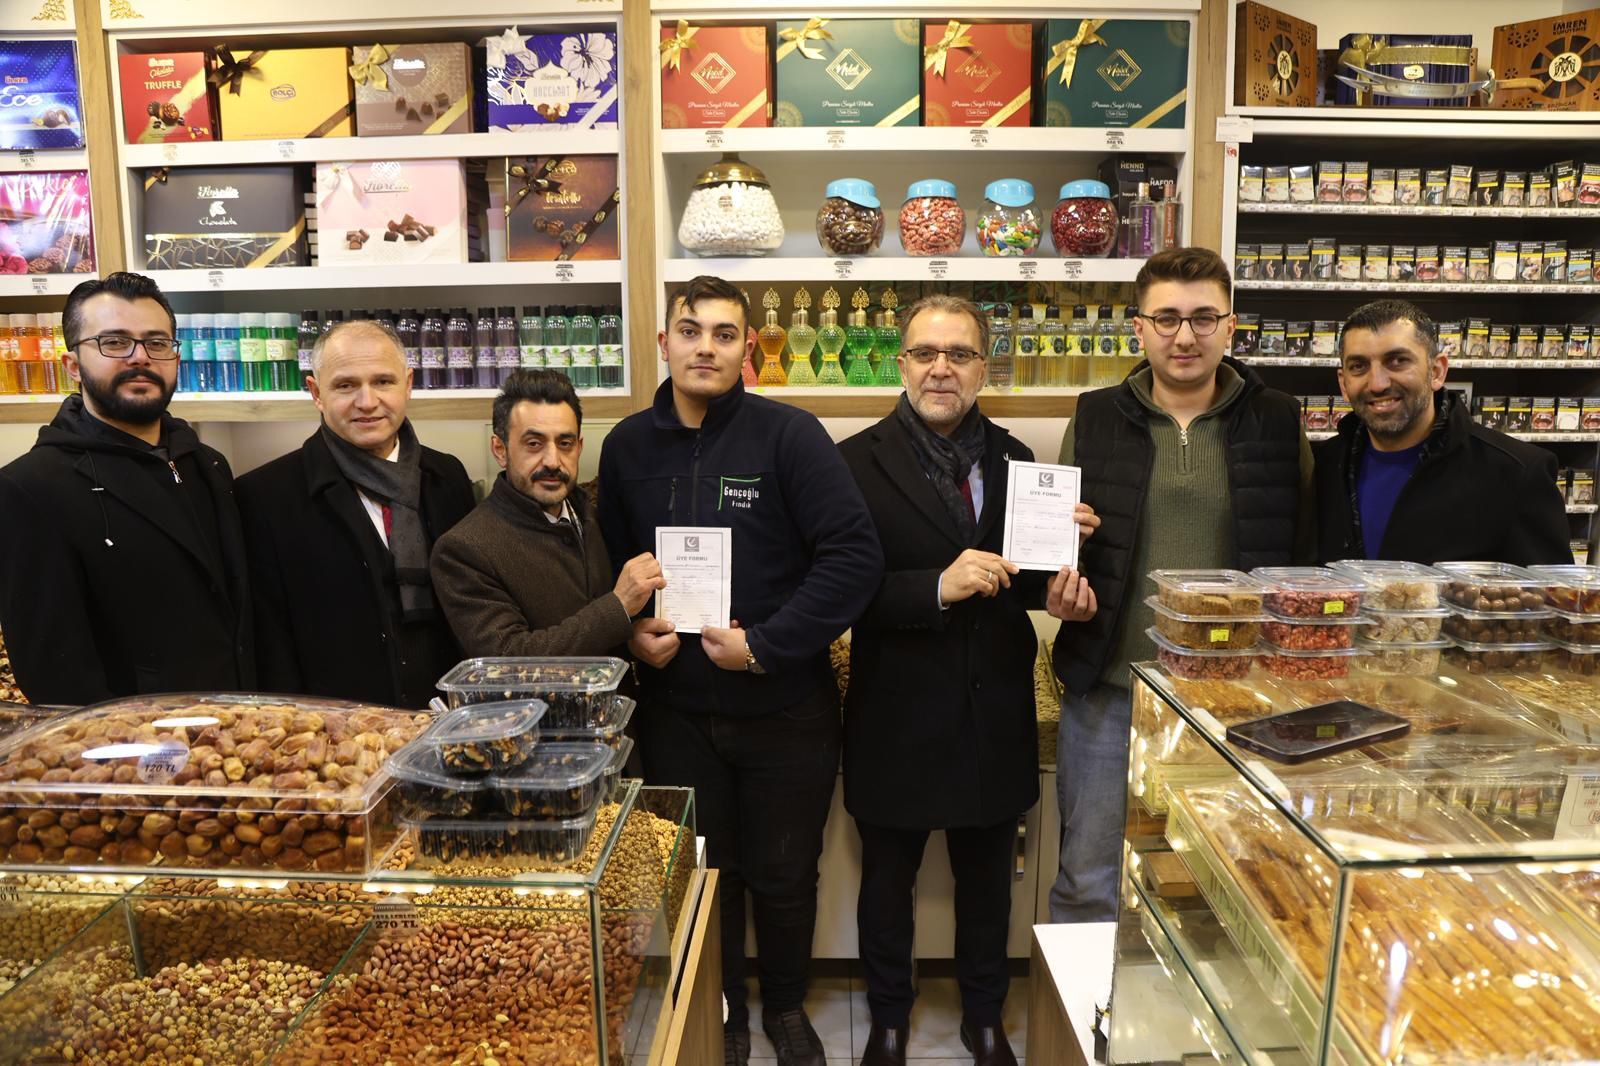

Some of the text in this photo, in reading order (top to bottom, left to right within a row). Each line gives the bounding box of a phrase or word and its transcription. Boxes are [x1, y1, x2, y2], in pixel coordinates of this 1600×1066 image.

[144, 80, 182, 90] TRUFFLE
[724, 486, 760, 500] Gençoğlu
[145, 764, 163, 772] 120
[375, 920, 419, 929] 270 TL
